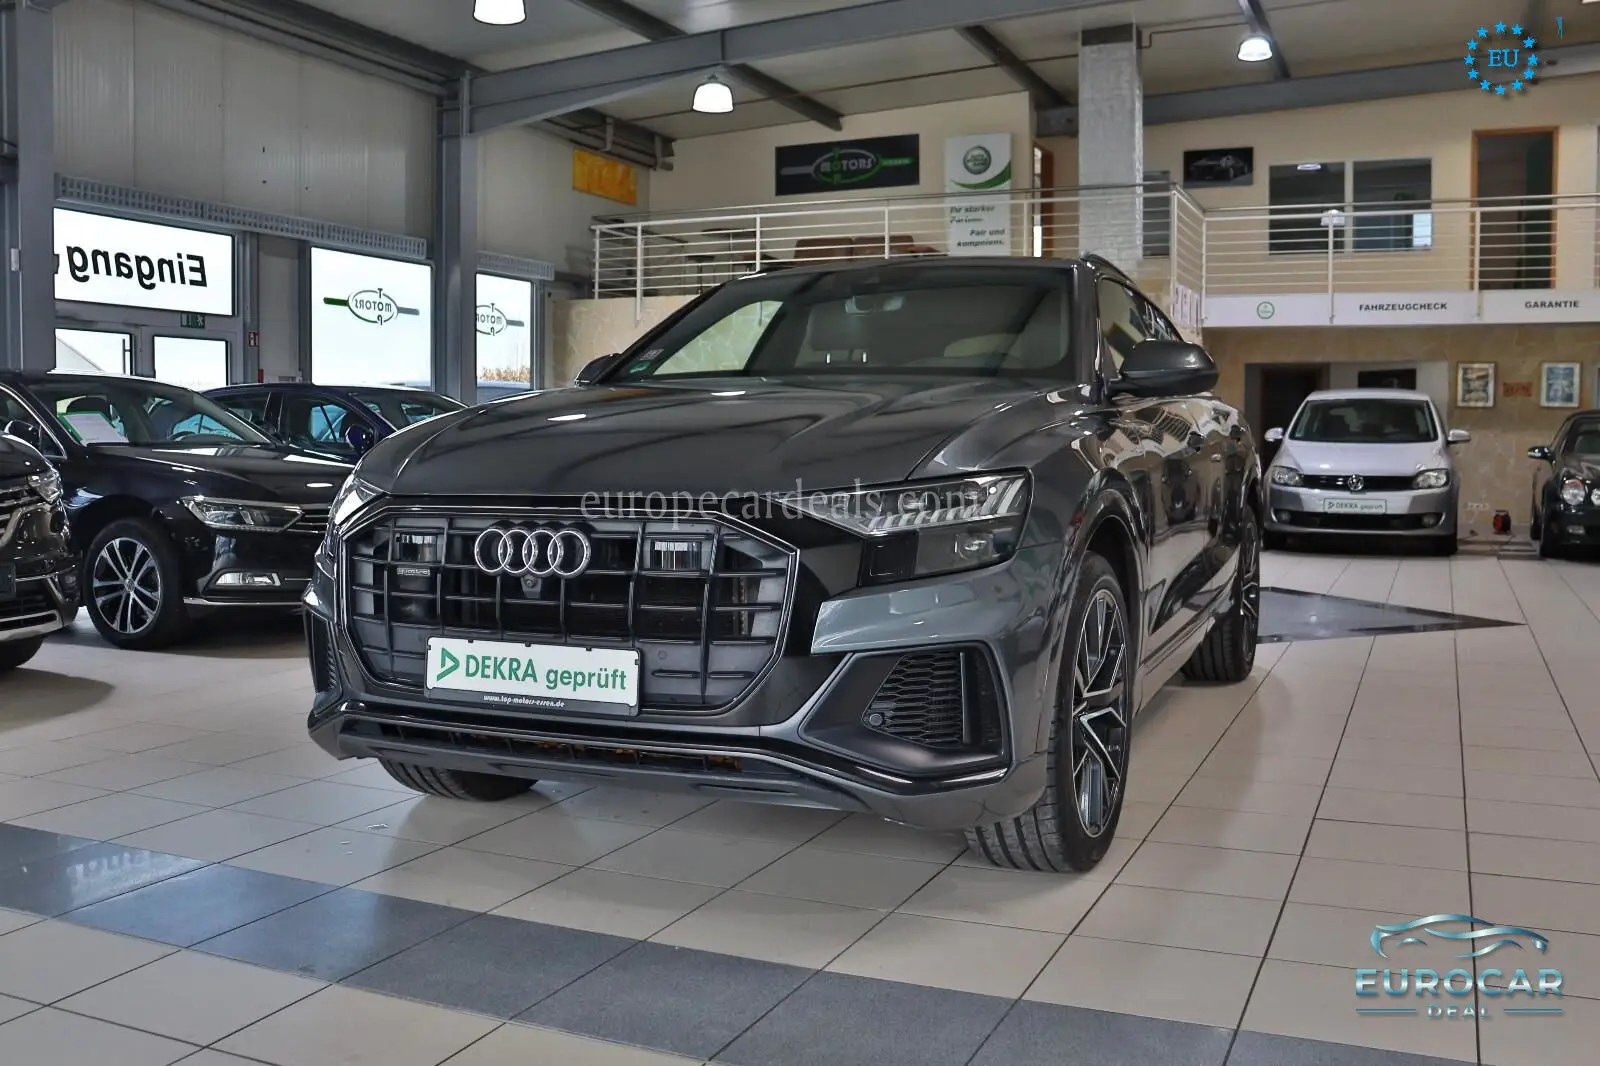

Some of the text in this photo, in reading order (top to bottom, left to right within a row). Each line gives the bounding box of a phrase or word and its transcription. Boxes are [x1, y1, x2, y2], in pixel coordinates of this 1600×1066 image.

[820, 158, 872, 172] MOTORS
[1359, 302, 1448, 312] FAHRZEUGCHECK
[1524, 300, 1580, 310] GARANTIE
[465, 654, 627, 692] DEKRA geprüft
